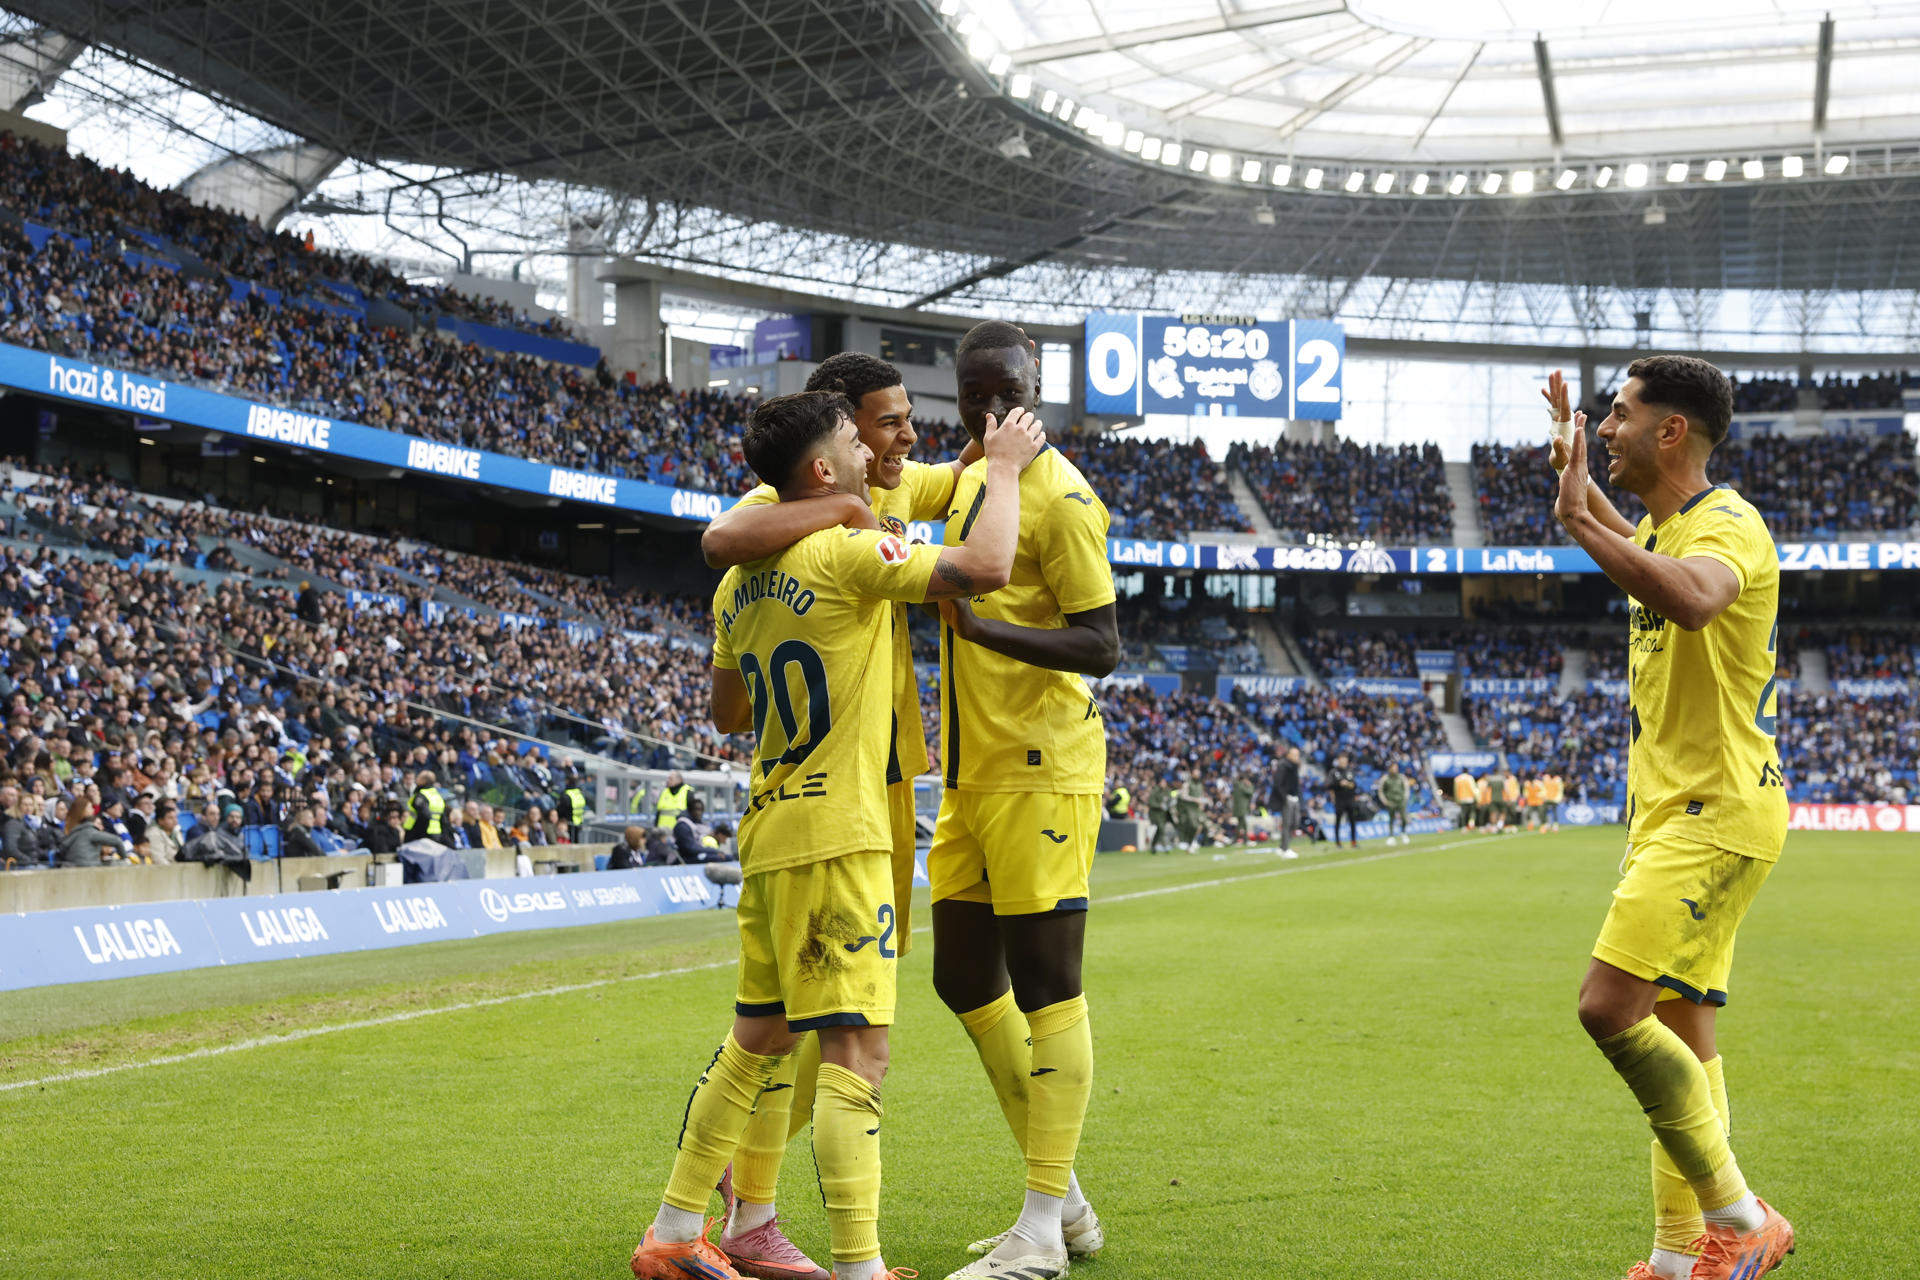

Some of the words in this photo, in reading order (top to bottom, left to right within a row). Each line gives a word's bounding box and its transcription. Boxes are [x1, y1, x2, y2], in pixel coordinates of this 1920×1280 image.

[1088, 331, 1137, 396] 0
[1163, 326, 1269, 360] 56:20
[49, 356, 98, 399] hazi
[122, 373, 166, 413] hezi
[1296, 339, 1341, 403] 2
[1426, 548, 1448, 572] 2
[721, 570, 816, 634] A.MOLEIRO
[1788, 806, 1871, 831] ALIGA
[371, 897, 448, 933] LALIGA
[503, 891, 567, 913] LEXUS
[73, 918, 182, 964] LALIGA
[240, 906, 330, 947] LALIGA
[877, 903, 896, 959] 2
